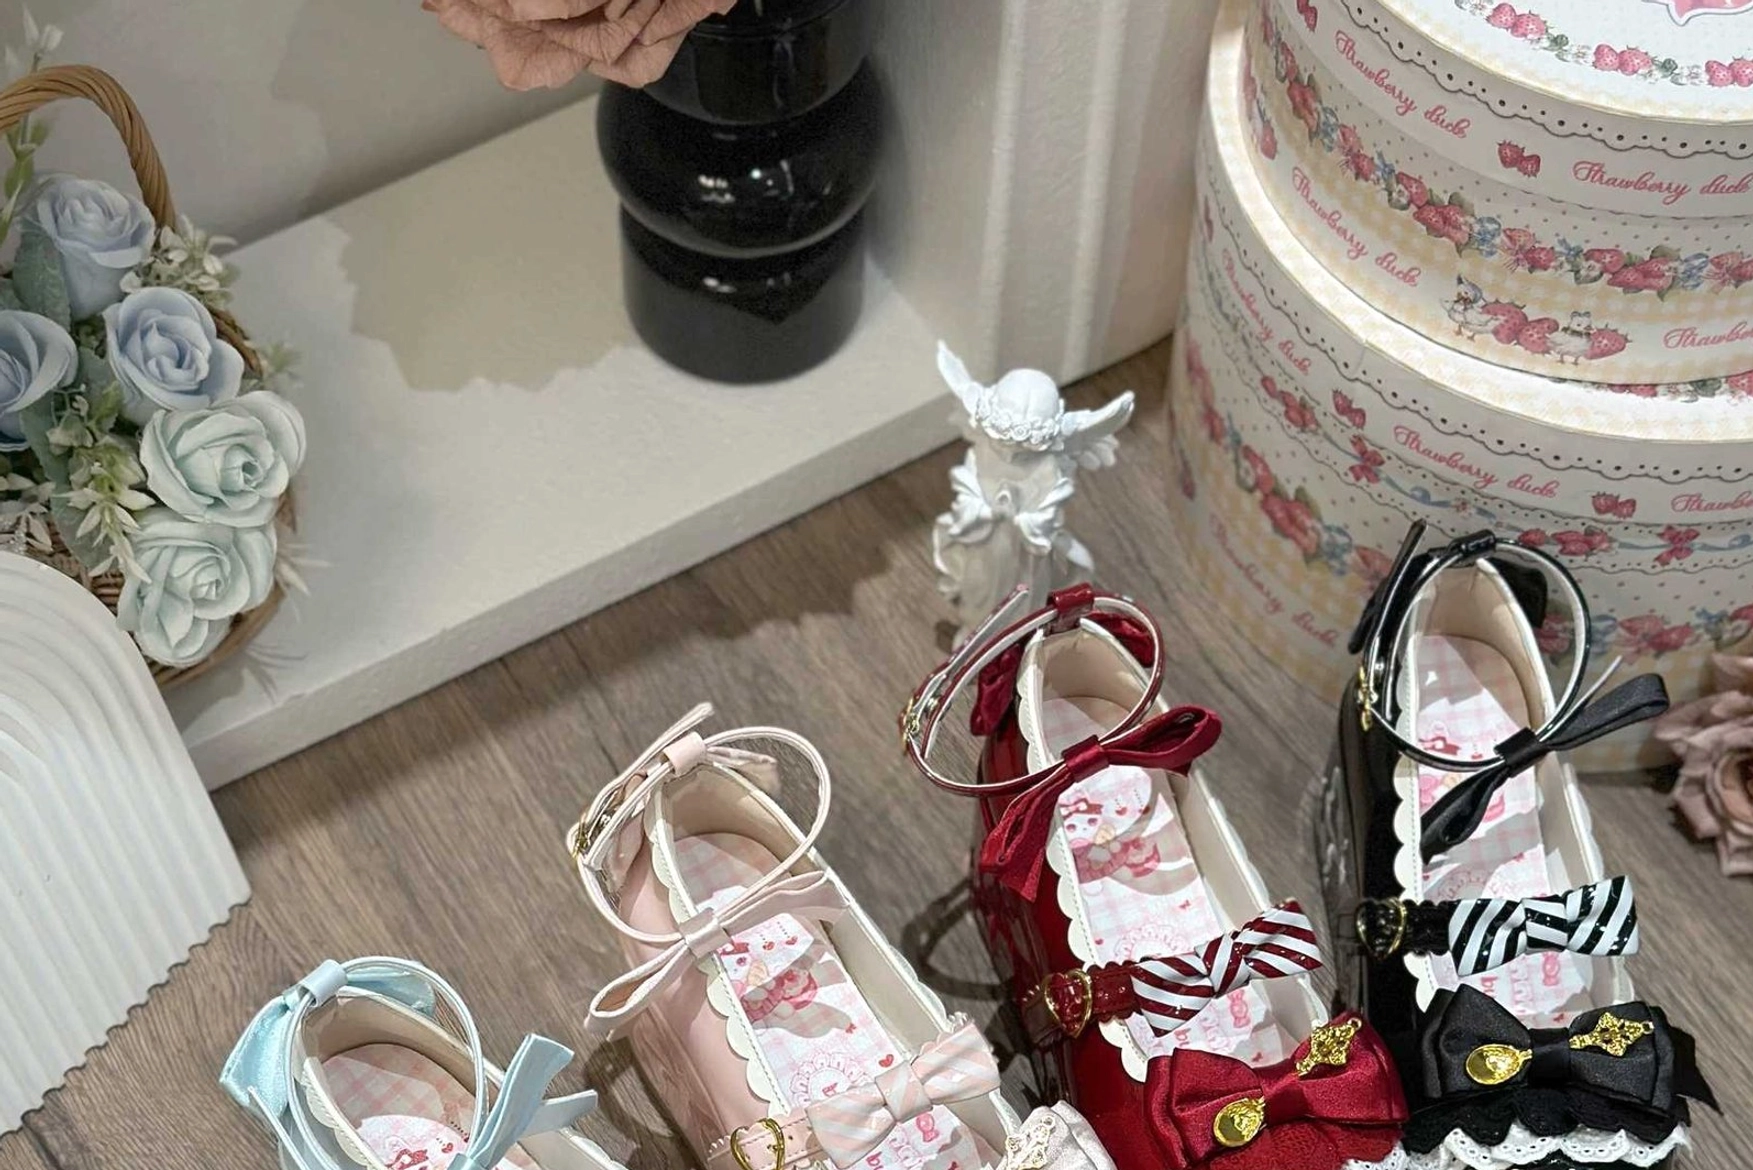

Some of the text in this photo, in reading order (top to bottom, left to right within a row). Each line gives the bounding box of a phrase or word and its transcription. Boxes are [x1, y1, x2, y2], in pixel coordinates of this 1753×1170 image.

[1335, 30, 1471, 139] Strawberry duck
[1292, 166, 1421, 287] Strawberry duck
[1573, 160, 1691, 206] Strawberry
[1393, 425, 1560, 498] Strawberry duck
